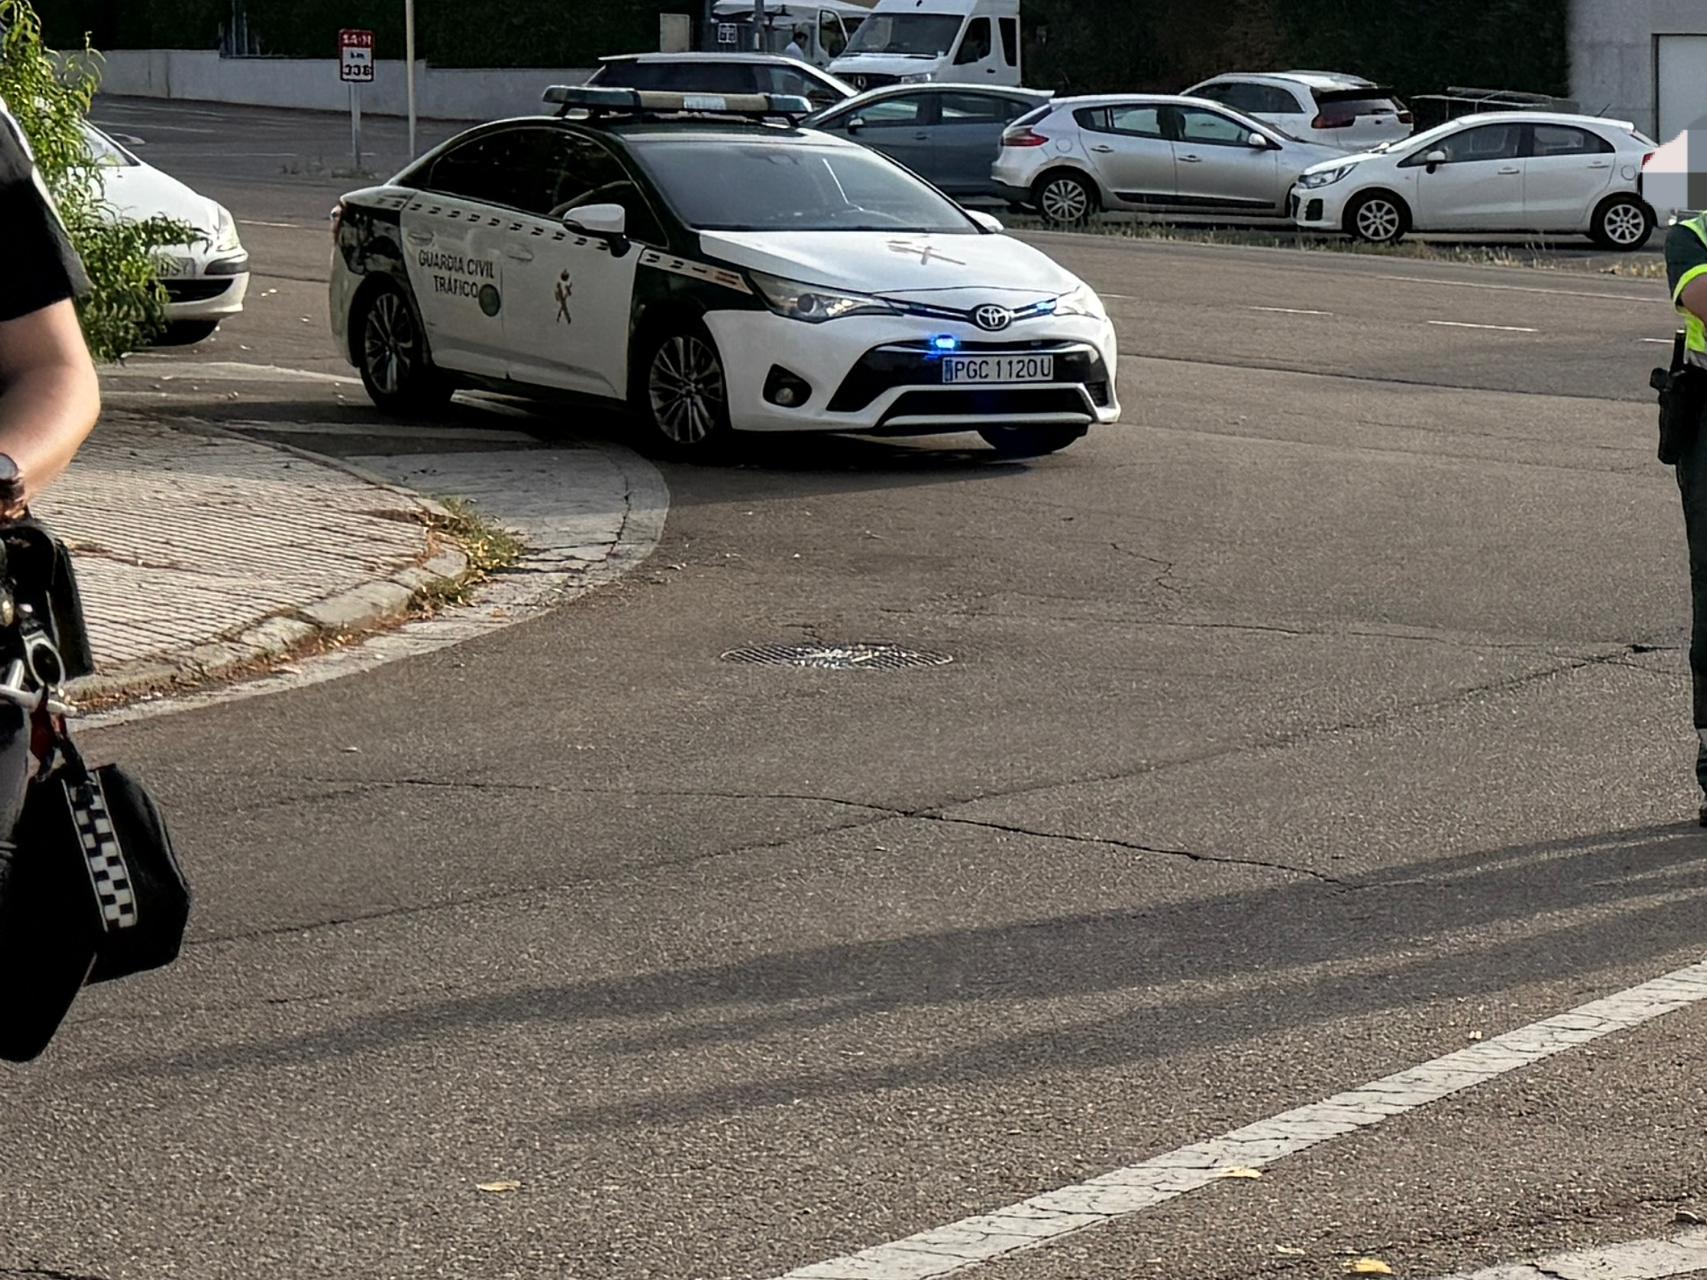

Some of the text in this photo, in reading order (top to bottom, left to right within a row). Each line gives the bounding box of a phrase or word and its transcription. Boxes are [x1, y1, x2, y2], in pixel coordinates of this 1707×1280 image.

[418, 249, 495, 279] GUARDIA CIVIL
[433, 273, 479, 298] TRÁFICO
[954, 359, 990, 379] PGC
